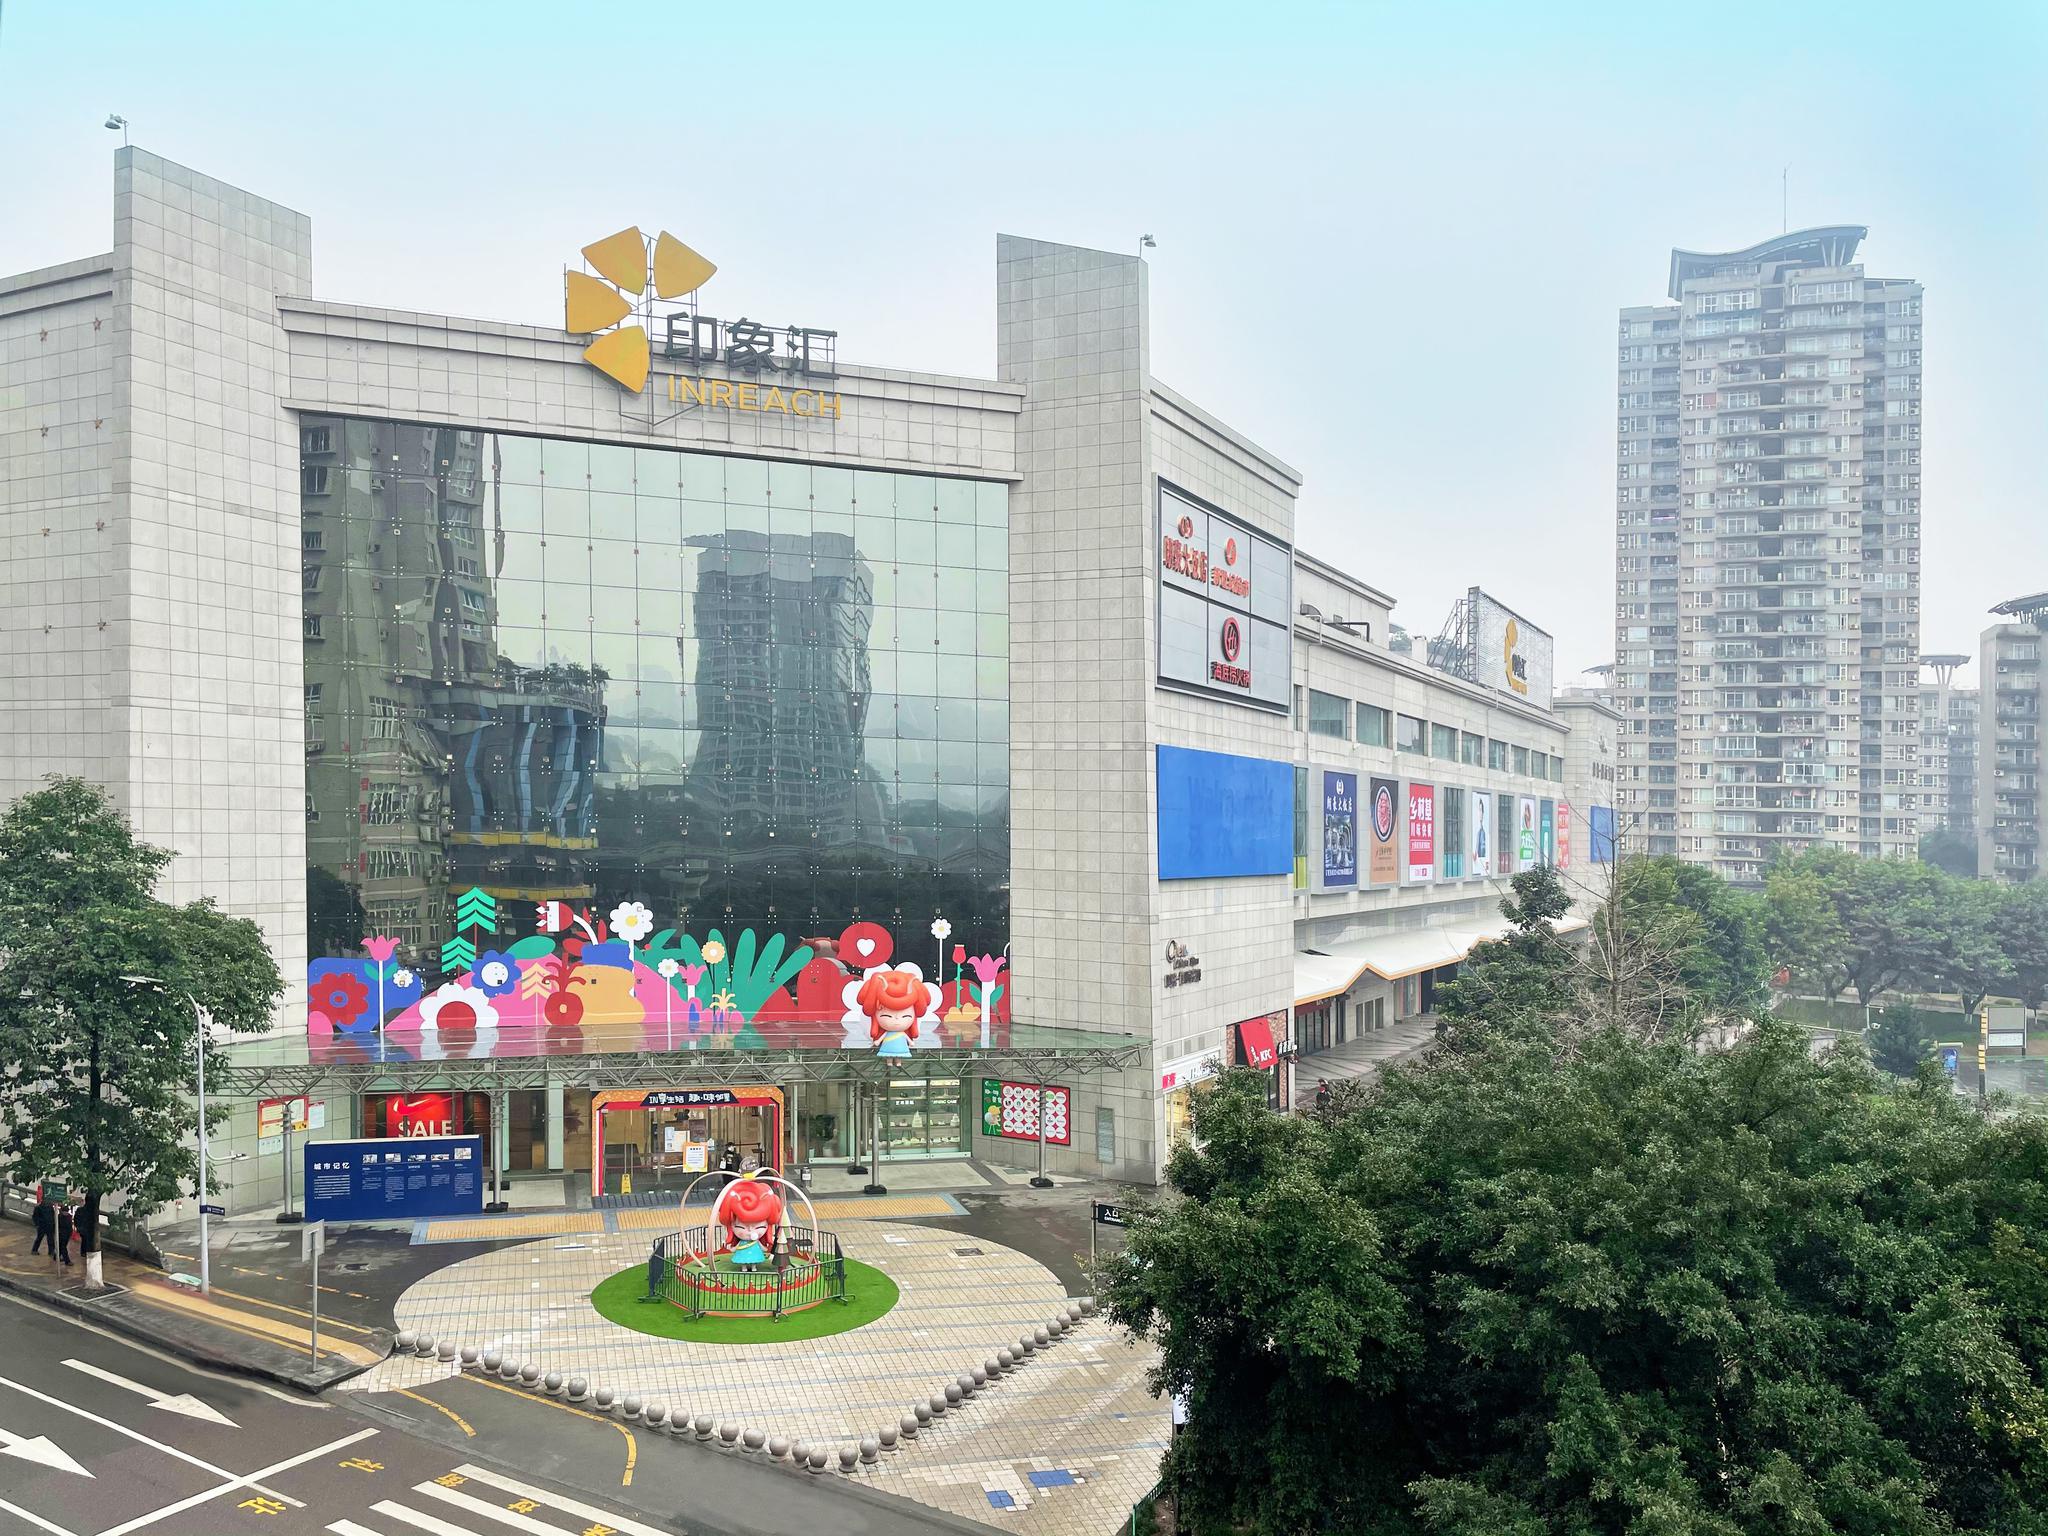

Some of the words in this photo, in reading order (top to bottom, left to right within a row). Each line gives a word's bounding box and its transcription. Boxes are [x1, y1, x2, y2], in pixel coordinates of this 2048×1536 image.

[664, 311, 840, 381] 印象汇
[667, 374, 842, 421] INREACH
[1409, 796, 1433, 821] 乡村基
[1260, 1048, 1273, 1062] KFC
[398, 1120, 453, 1138] SALE
[313, 1162, 351, 1171] 城市记忆
[1104, 1208, 1119, 1218] 入口
